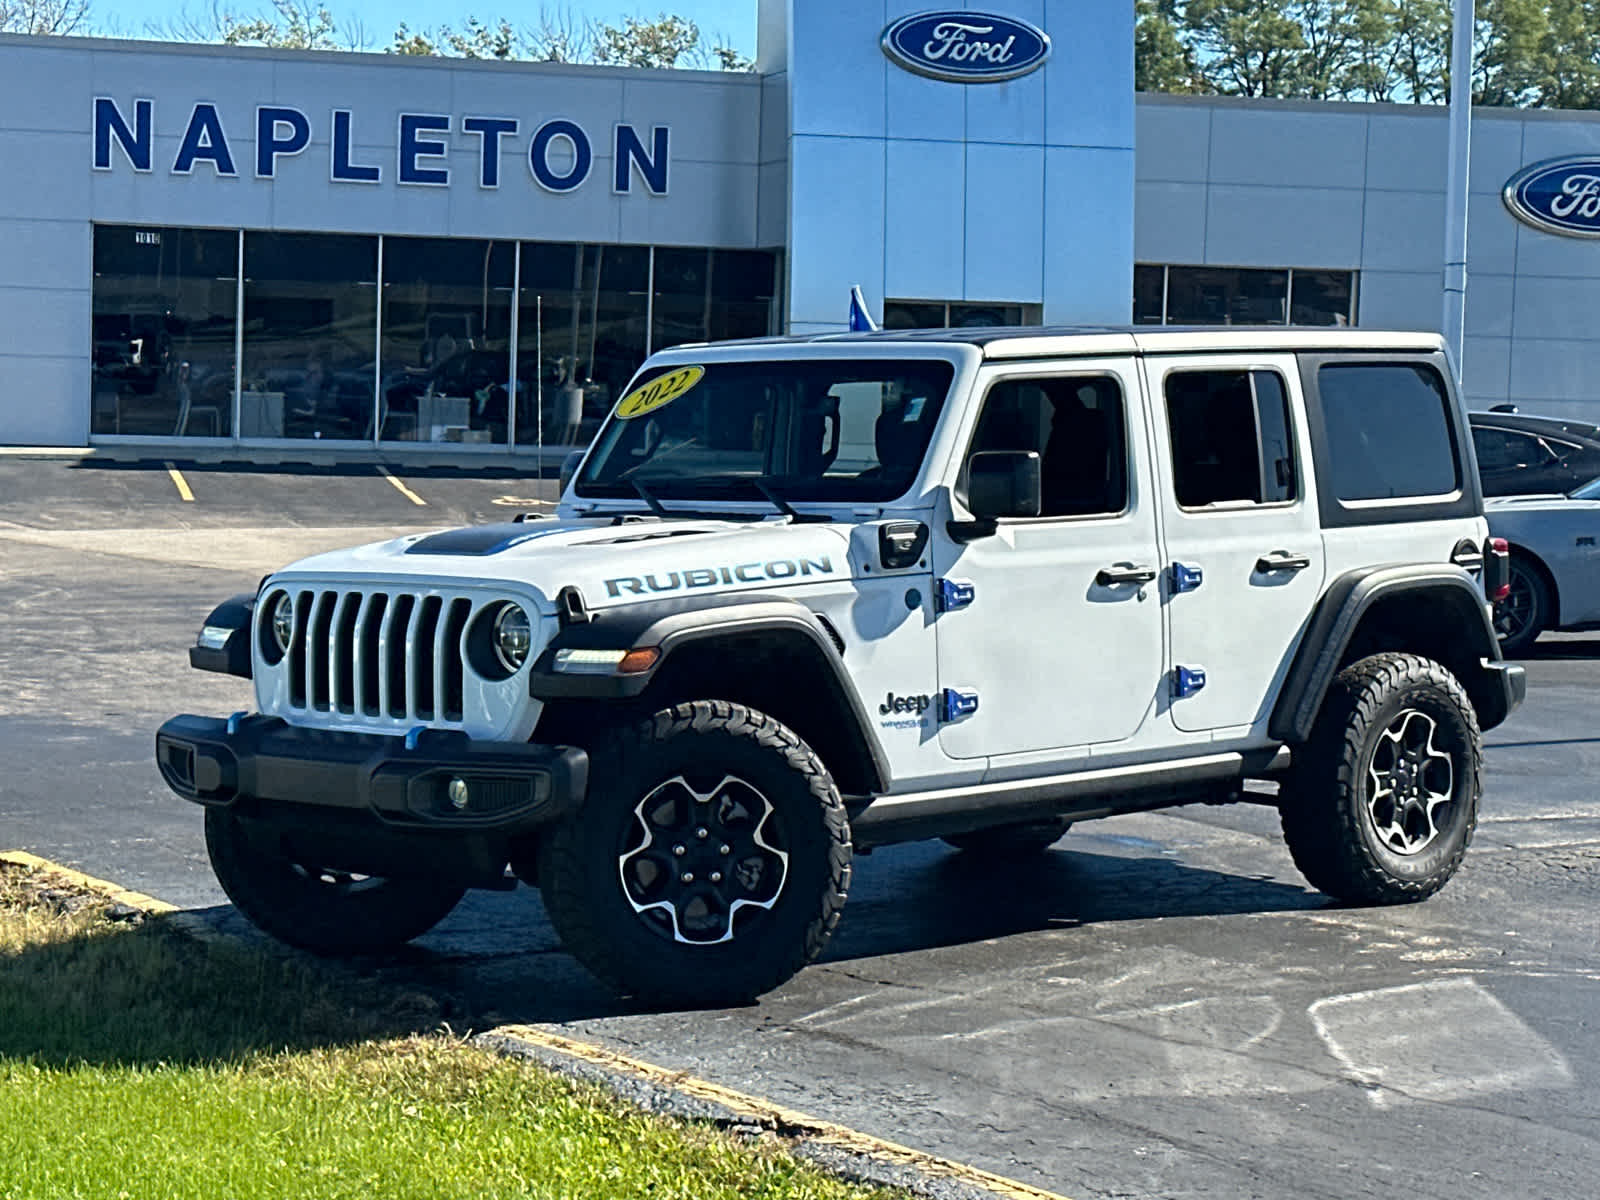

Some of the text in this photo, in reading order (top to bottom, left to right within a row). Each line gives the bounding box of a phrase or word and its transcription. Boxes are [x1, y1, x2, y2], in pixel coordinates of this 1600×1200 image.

[923, 22, 1016, 63] Ford
[92, 97, 671, 196] NAPLETON
[629, 370, 690, 414] 2022
[603, 556, 833, 598] RUBICON
[879, 692, 930, 716] Jeep
